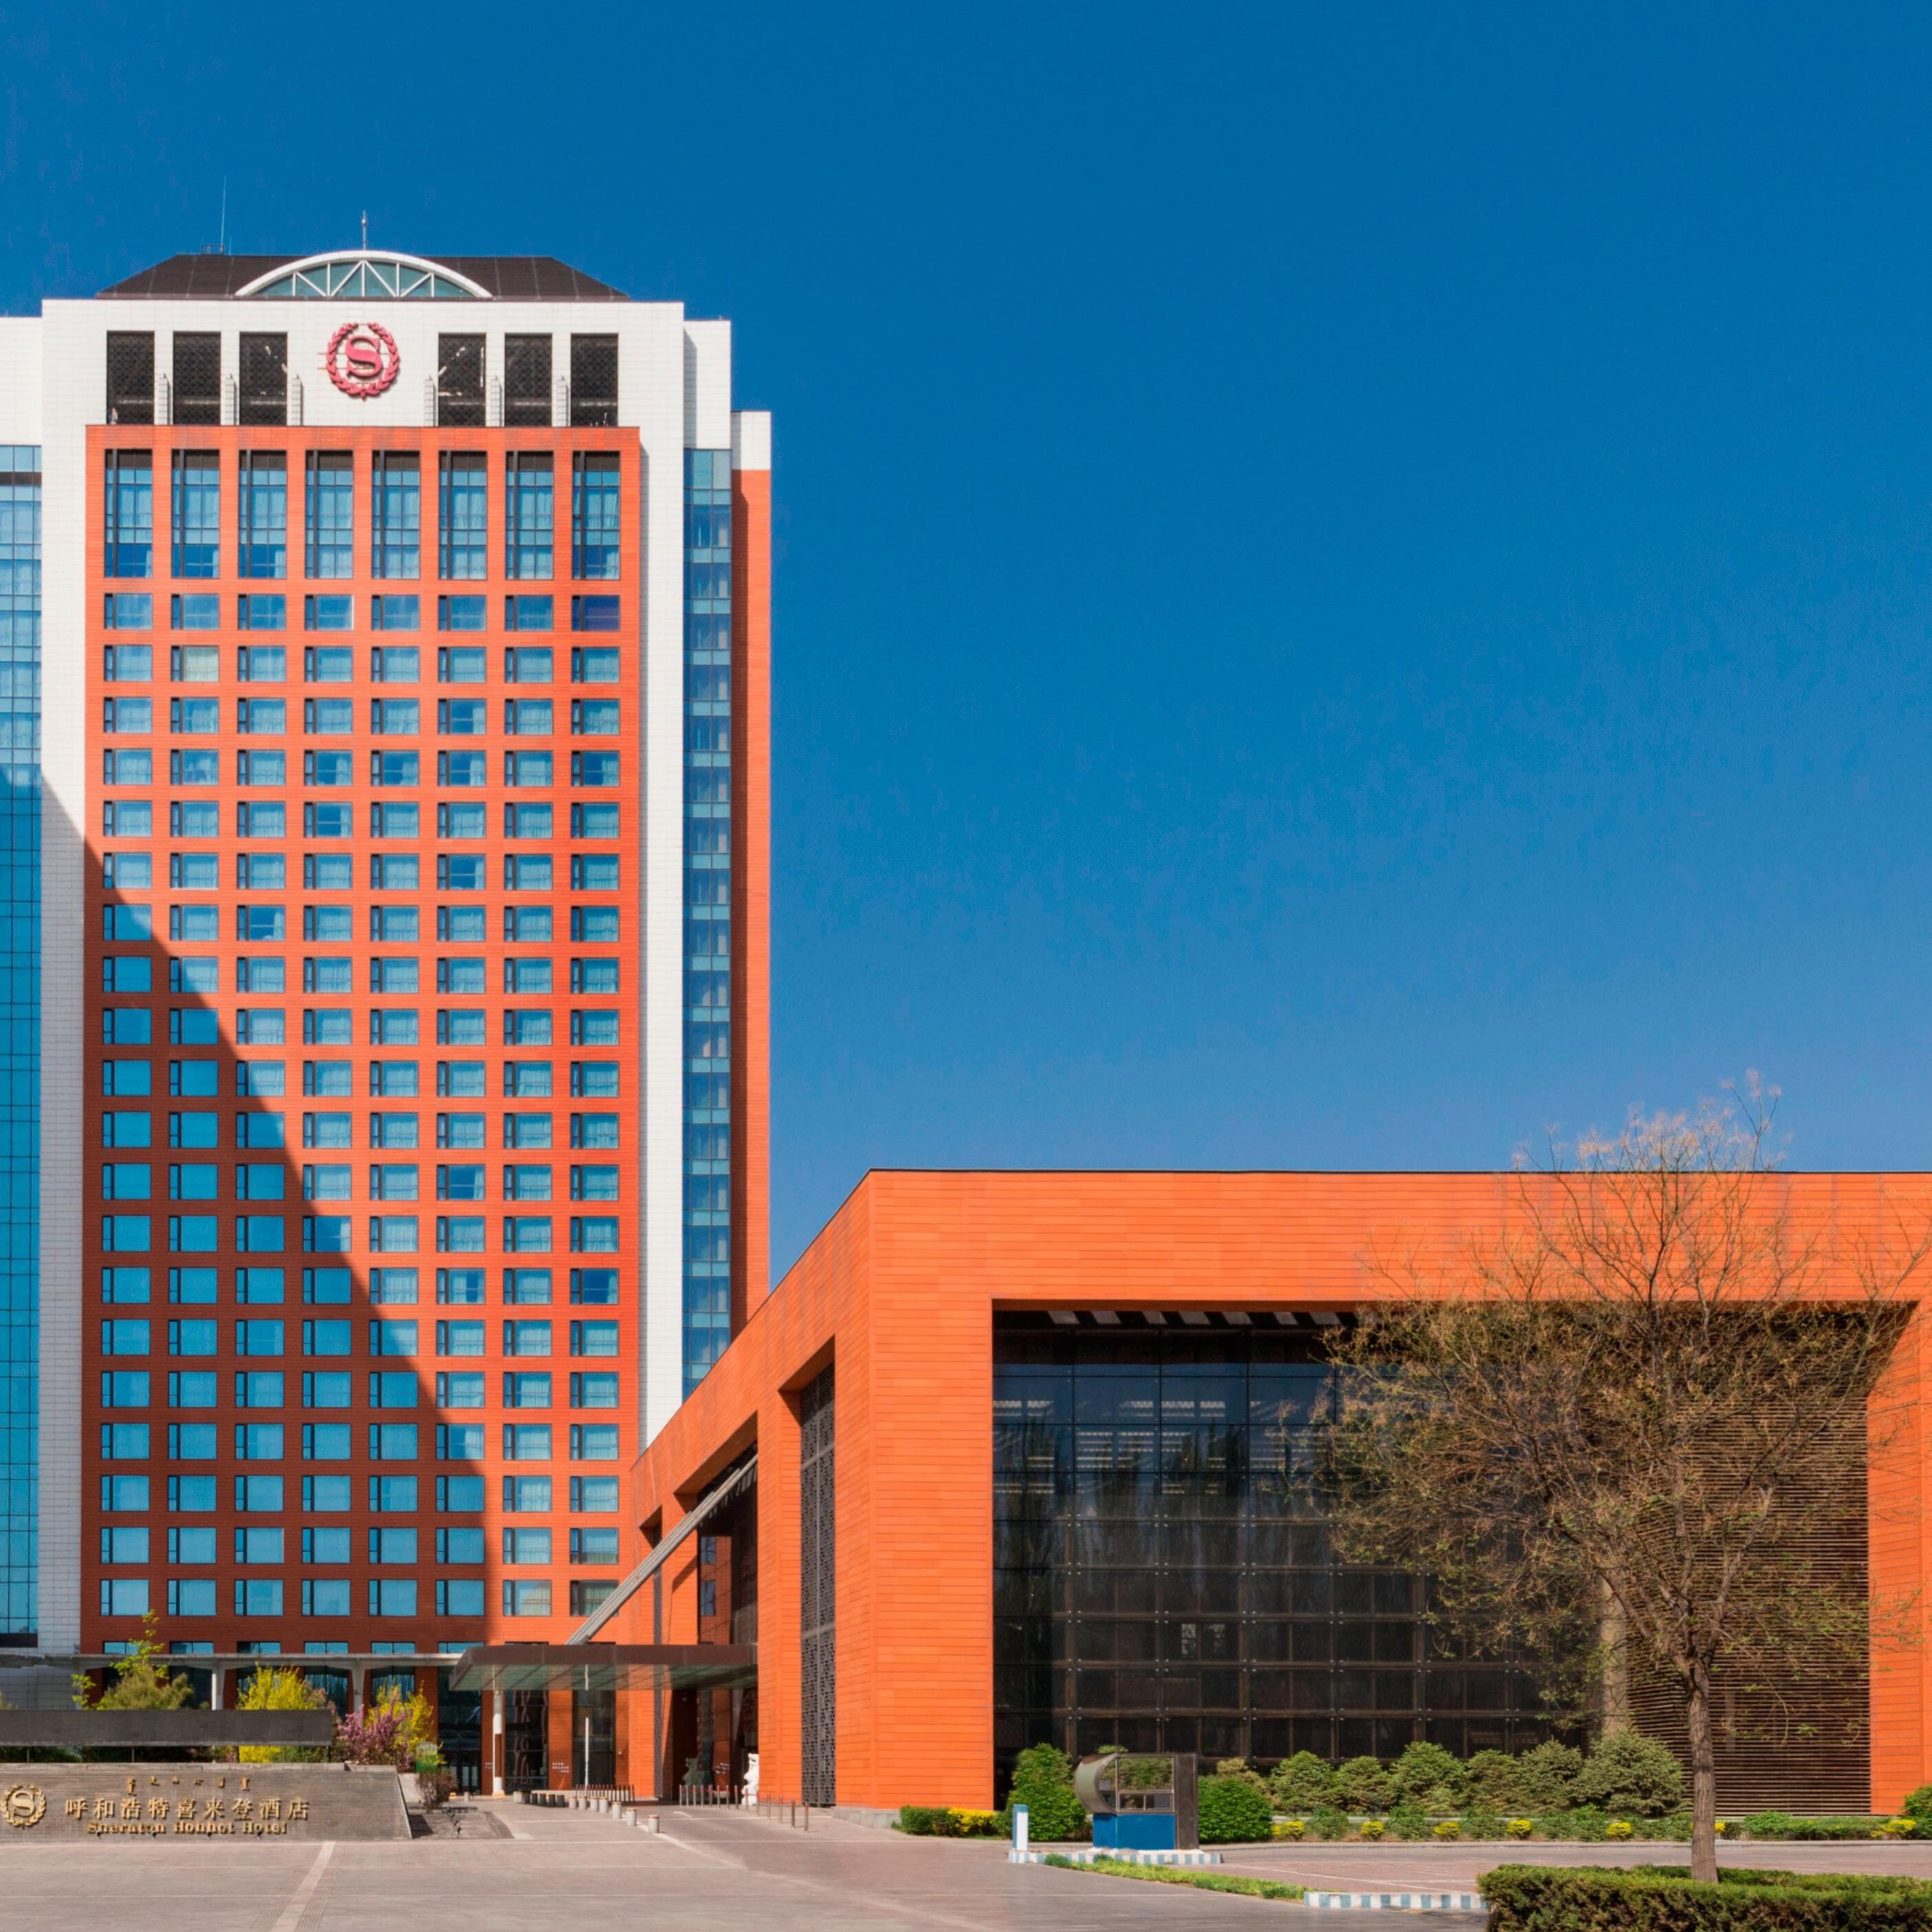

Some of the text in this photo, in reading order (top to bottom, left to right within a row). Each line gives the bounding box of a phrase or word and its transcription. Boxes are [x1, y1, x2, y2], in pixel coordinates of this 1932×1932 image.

[345, 335, 383, 378] S
[12, 1792, 36, 1818] S
[65, 1797, 309, 1820] 呼和浩特喜来登酒店
[88, 1820, 167, 1834] Sheraton
[242, 1820, 287, 1834] Hotel
